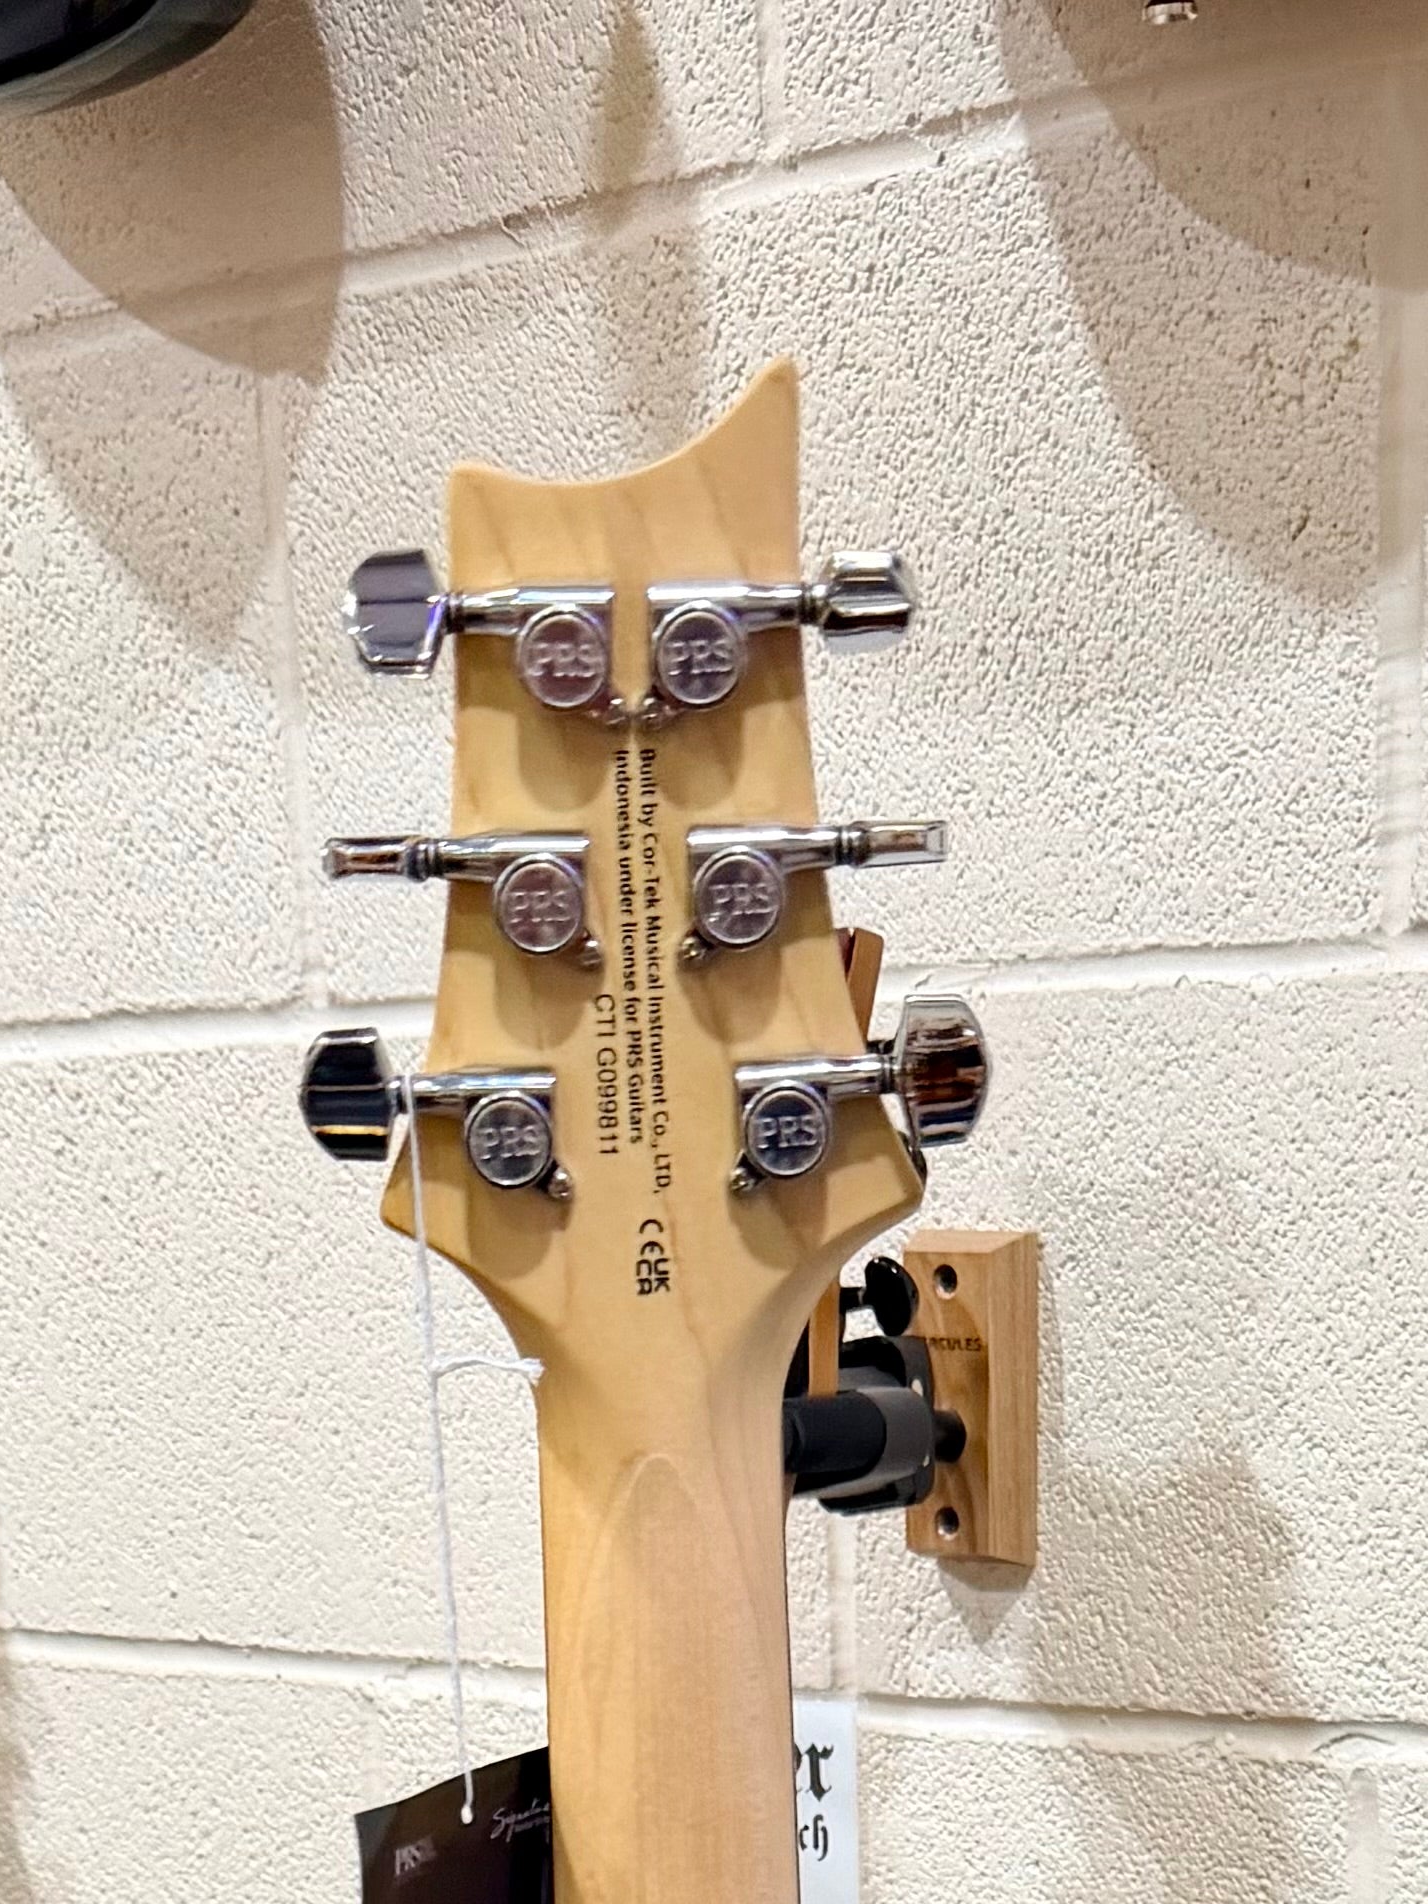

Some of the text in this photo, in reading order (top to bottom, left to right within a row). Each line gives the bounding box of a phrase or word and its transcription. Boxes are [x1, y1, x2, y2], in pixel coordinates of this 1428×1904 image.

[528, 642, 596, 678] PRS
[669, 638, 733, 676] PRS
[639, 748, 657, 797] Built
[637, 802, 659, 828] by
[642, 832, 665, 913] Cor-Tek
[508, 890, 572, 925] PRS
[615, 749, 647, 1144] Indonesia under license for PRS Guitars
[644, 914, 666, 991] Musical
[648, 996, 670, 1104] Instrument
[596, 1047, 621, 1154] G099811
[478, 1124, 541, 1161] PRS
[756, 1114, 818, 1150] PRS
